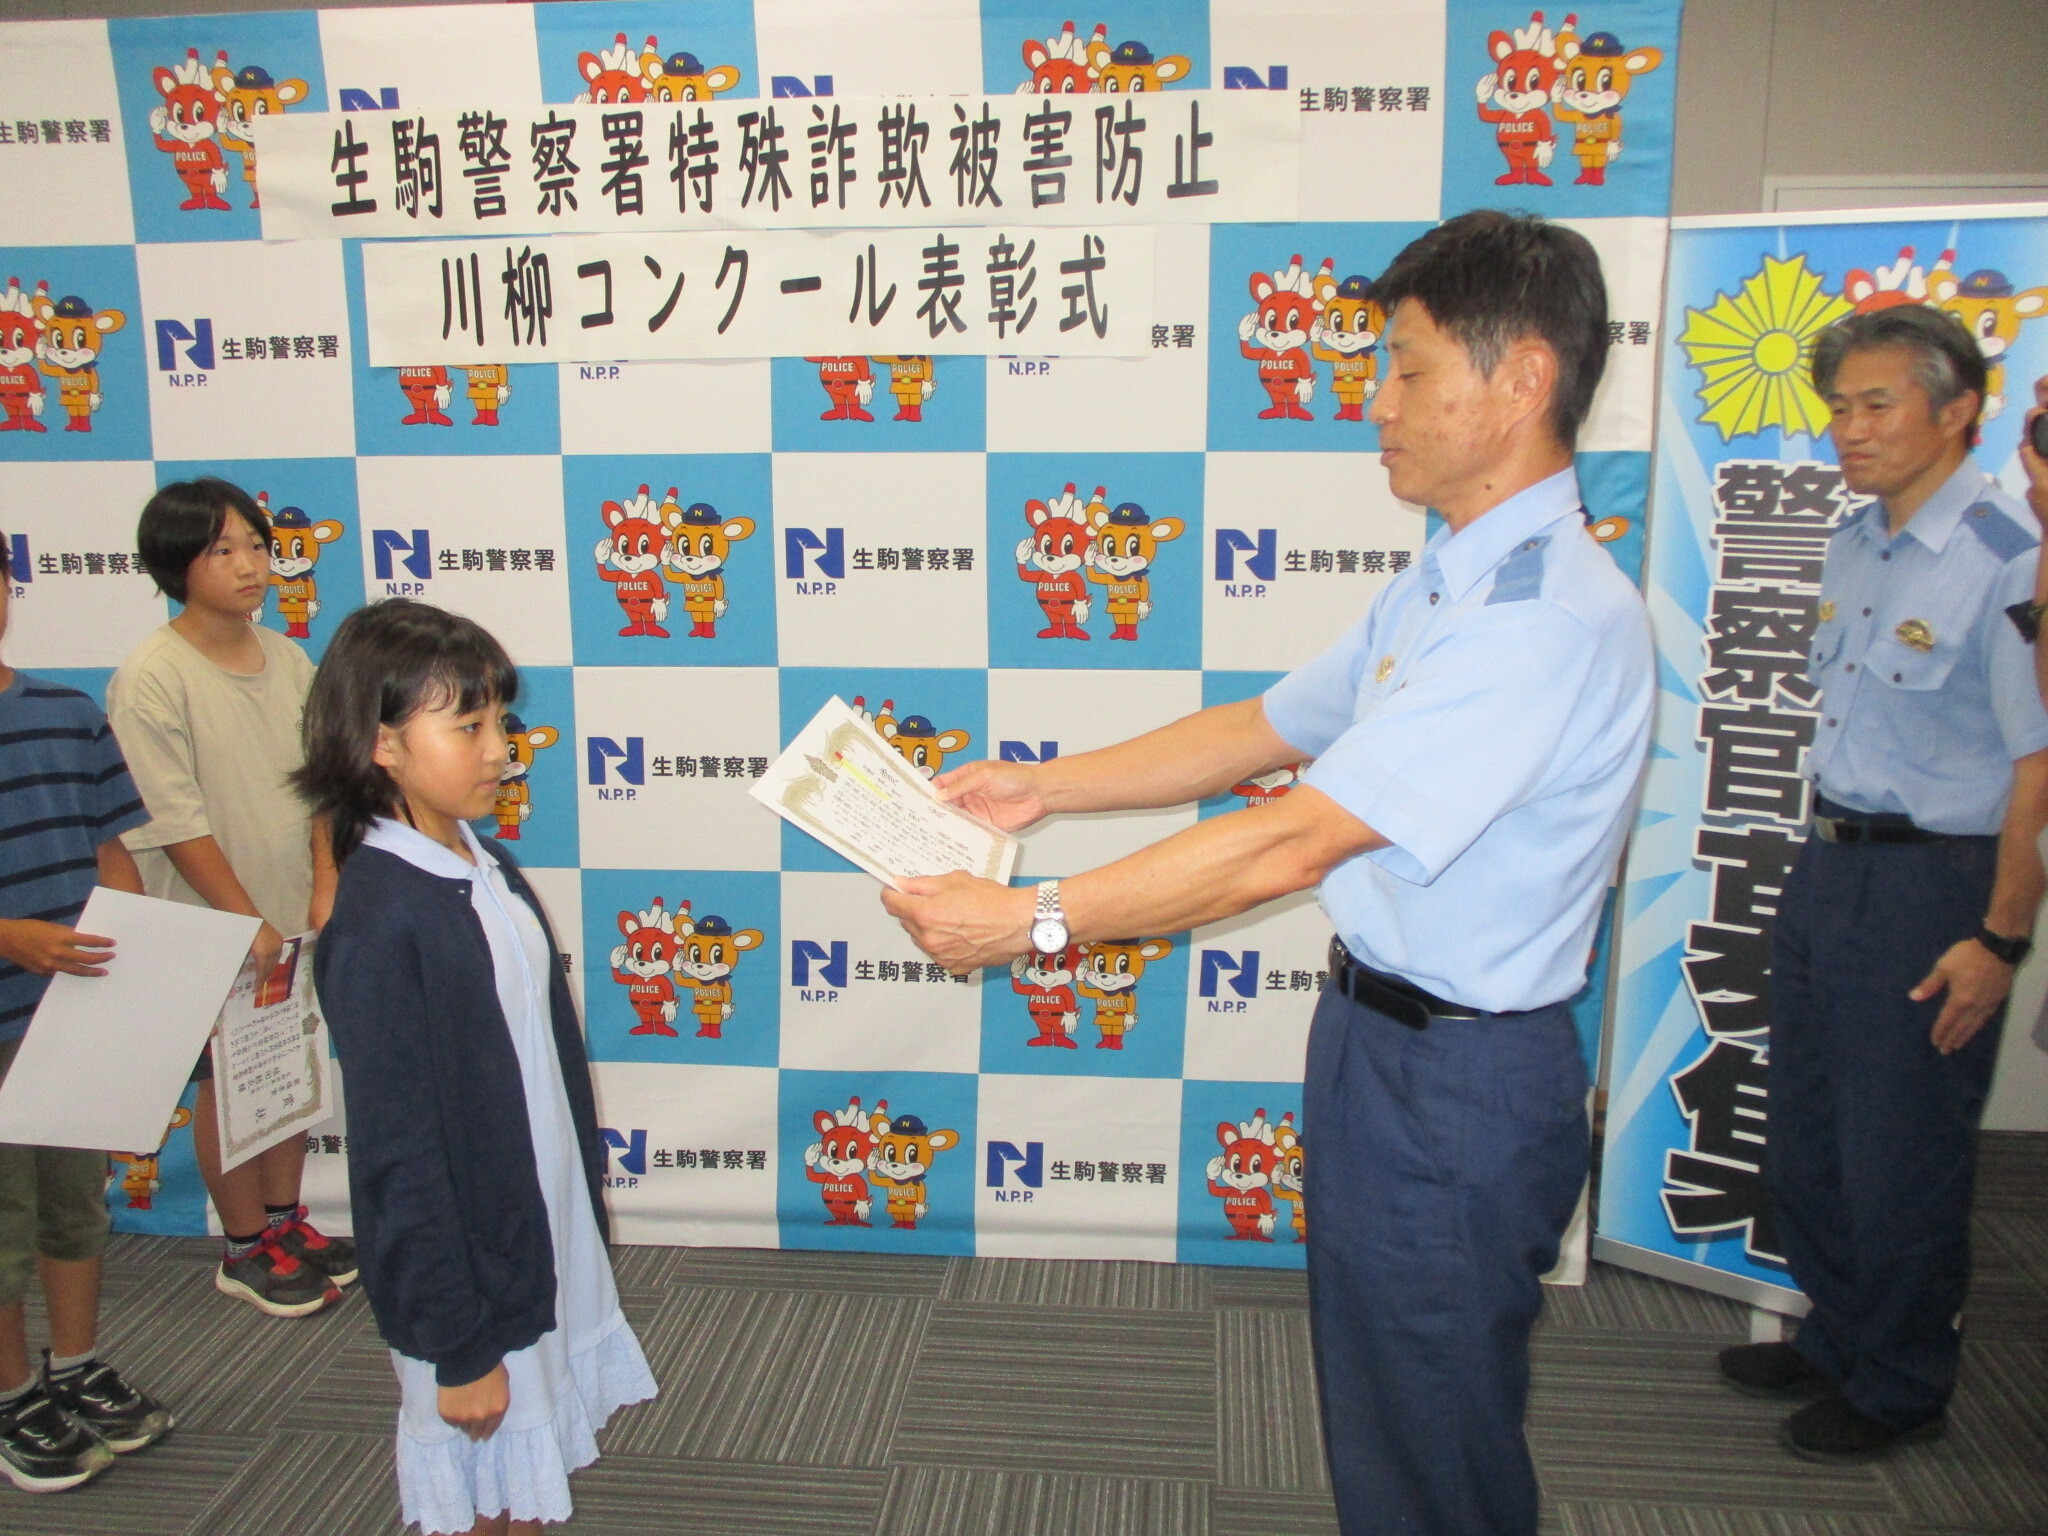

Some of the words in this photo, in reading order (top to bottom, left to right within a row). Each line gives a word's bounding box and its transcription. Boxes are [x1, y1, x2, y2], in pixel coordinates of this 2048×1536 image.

[1300, 86, 1430, 112] 生駒警察署
[1499, 122, 1534, 133] POLICE
[175, 151, 207, 162] POLICE
[331, 99, 1219, 219] 生駒警察署特殊詐欺被害防止
[442, 233, 1108, 346] 川柳コンクール表彰式
[222, 335, 340, 361] 生駒警察署
[821, 362, 853, 372] POLICE
[893, 363, 921, 374] POLICE
[1009, 362, 1050, 376] N.P.P.
[1261, 359, 1294, 370] POLICE
[1334, 361, 1364, 372] POLICE
[401, 367, 431, 378] POLICE
[468, 369, 496, 379] POLICE
[580, 366, 620, 380] N.P.P.
[0, 375, 26, 385] OLICE
[169, 374, 208, 387] N.P.P.
[438, 549, 555, 572] 生駒警察署
[852, 547, 975, 572] 生駒警察署
[1284, 549, 1412, 574] 生駒警察署
[386, 583, 424, 596] N.P.P.
[617, 581, 648, 592] POLICE
[686, 583, 714, 593] POLICE
[796, 582, 836, 595] N.P.P.
[1038, 582, 1070, 593] POLICE
[1109, 584, 1138, 595] POLICE
[1225, 584, 1266, 598] N.P.P.
[652, 755, 770, 779] 生駒警察署
[496, 788, 519, 797] OLICE
[598, 788, 636, 801] N.P.P.
[630, 984, 659, 994] POLICE
[694, 987, 721, 998] POLICE
[800, 989, 838, 1002] N.P.P.
[1030, 994, 1060, 1005] POLICE
[1097, 998, 1125, 1008] POLICE
[1207, 1000, 1247, 1014] N.P.P.
[653, 1149, 767, 1171] 生駒警察署
[1050, 1161, 1167, 1184] 生駒警察署
[824, 1182, 853, 1193] POLICE
[888, 1187, 916, 1197] POLICE
[995, 1190, 1033, 1203] N.P.P.
[1225, 1196, 1257, 1207] POLICE
